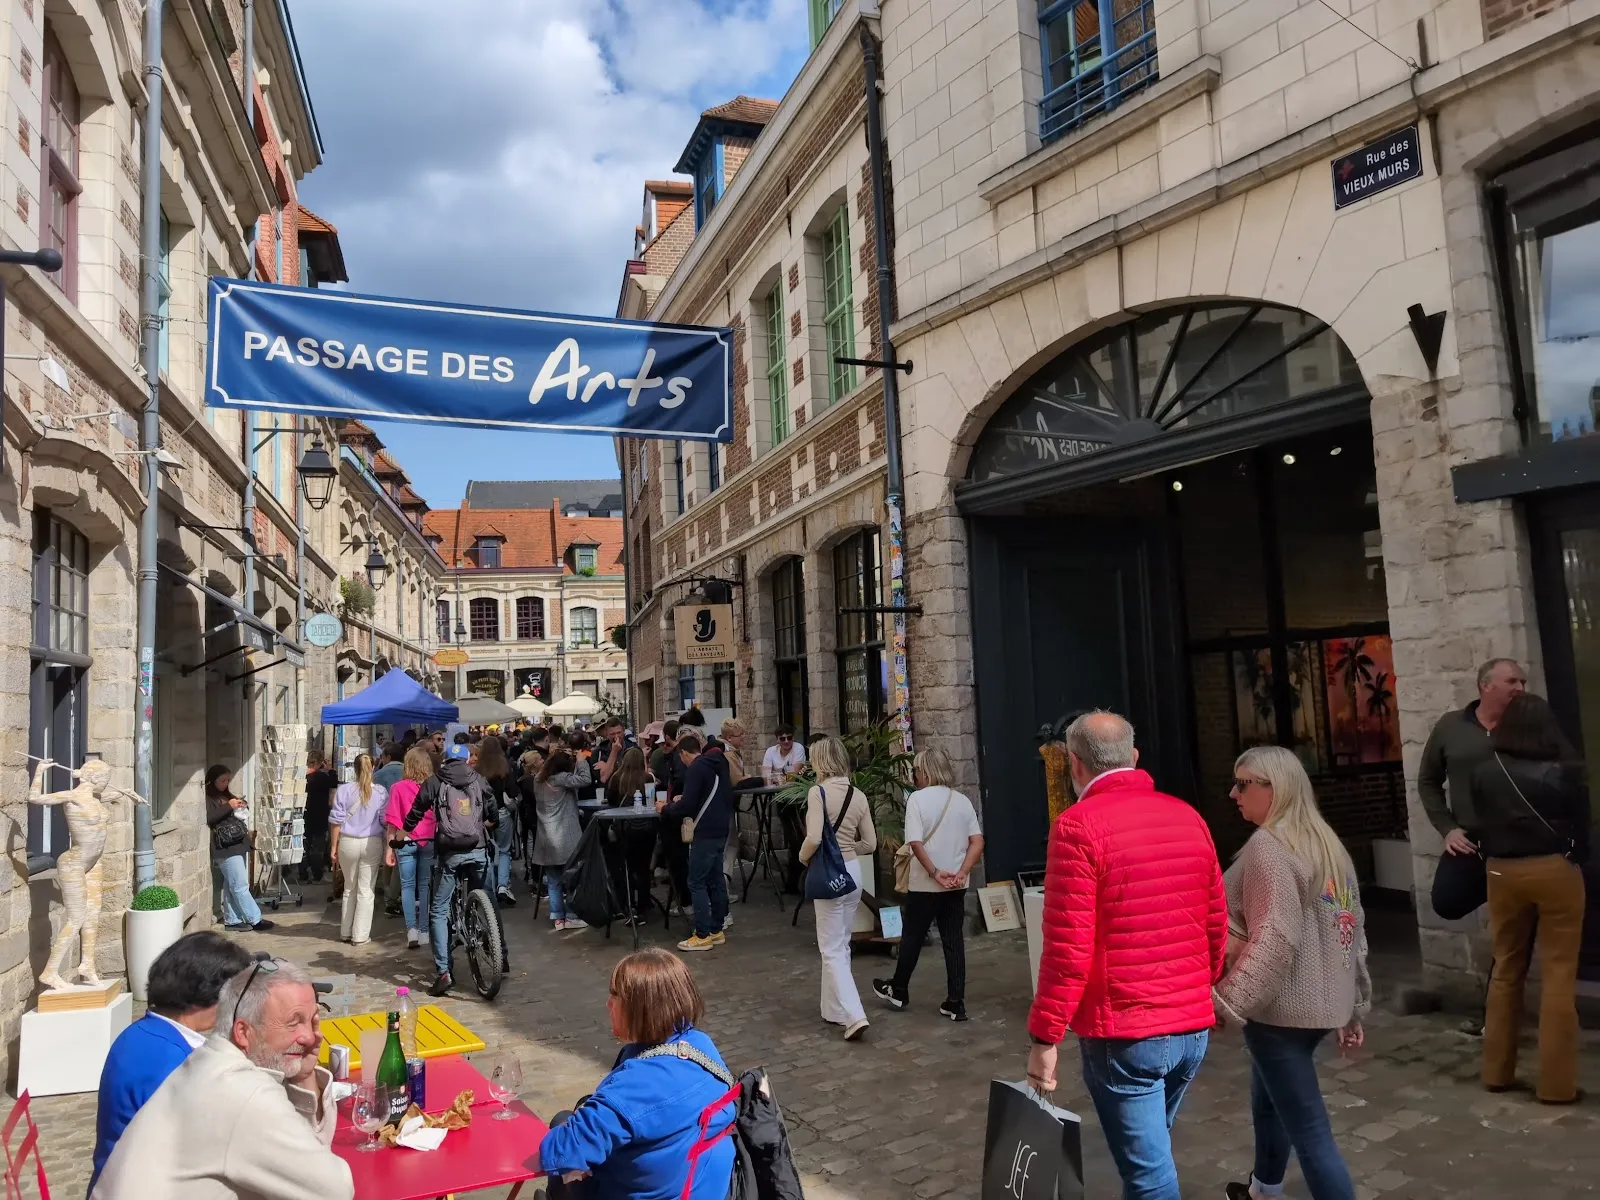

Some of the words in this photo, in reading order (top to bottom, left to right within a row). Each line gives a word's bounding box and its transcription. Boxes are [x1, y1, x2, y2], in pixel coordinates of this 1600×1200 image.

[1366, 150, 1386, 166] Rue
[1389, 140, 1409, 155] des
[1343, 172, 1375, 196] VIEUX
[1378, 158, 1410, 181] MURS
[243, 330, 429, 376] PASSAGE
[441, 351, 515, 383] DES
[528, 337, 694, 410] Arts
